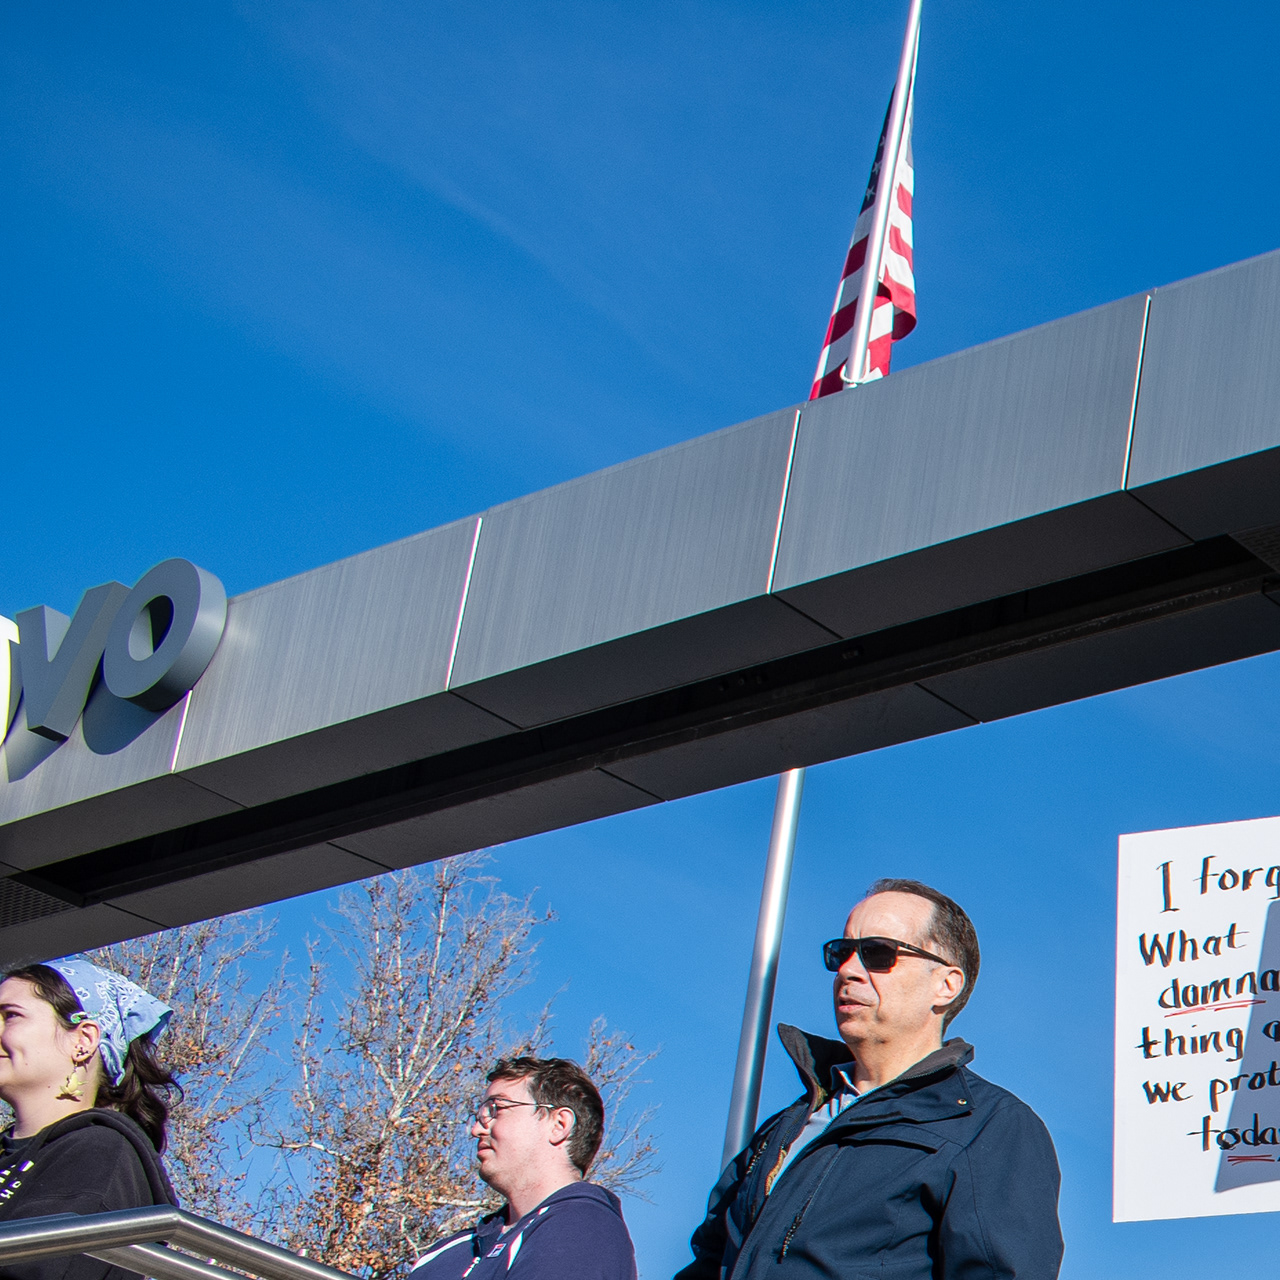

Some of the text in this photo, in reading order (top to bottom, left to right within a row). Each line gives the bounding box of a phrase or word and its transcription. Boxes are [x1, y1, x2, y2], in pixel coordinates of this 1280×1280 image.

[1156, 860, 1180, 913] I
[1138, 922, 1250, 968] What
[1134, 1024, 1244, 1062] thing
